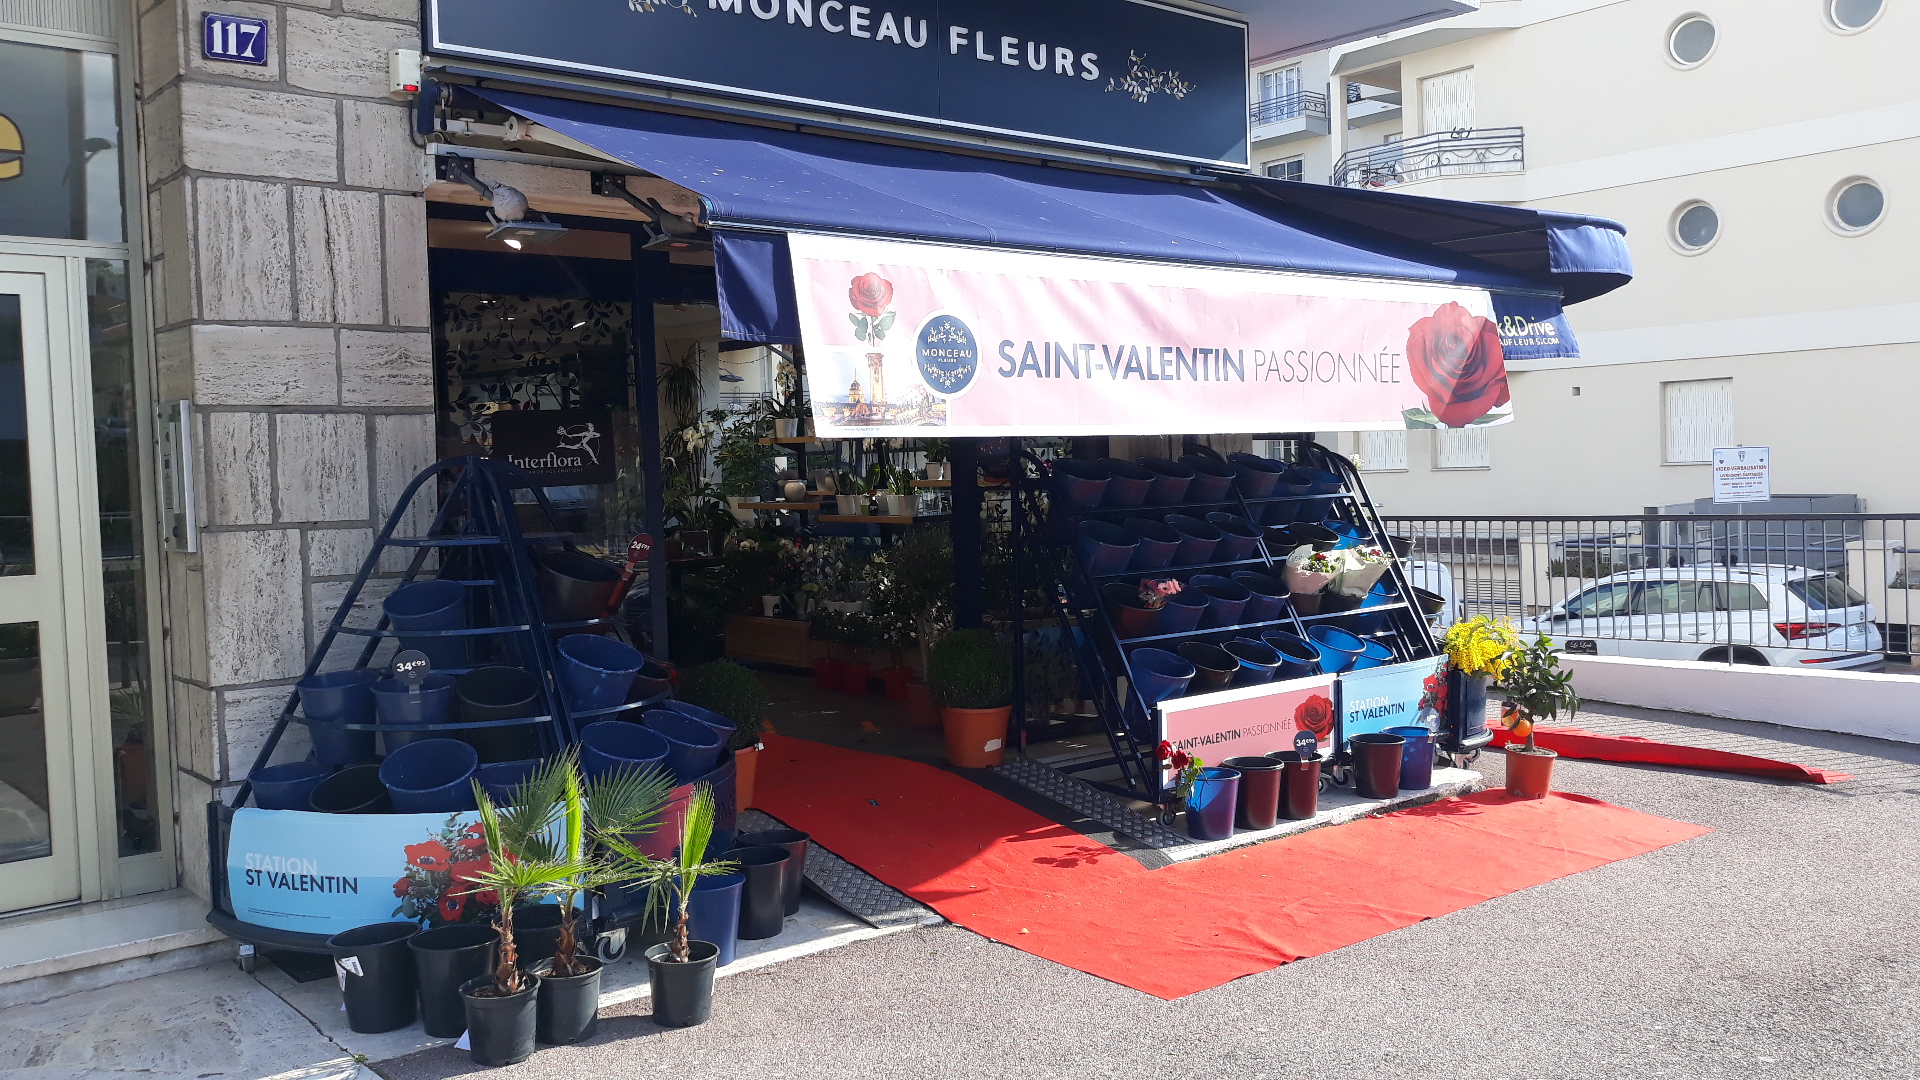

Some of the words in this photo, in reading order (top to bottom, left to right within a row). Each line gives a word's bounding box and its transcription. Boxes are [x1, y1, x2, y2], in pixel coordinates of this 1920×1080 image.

[211, 20, 261, 58] 117
[950, 25, 1100, 81] FLEURS
[922, 348, 972, 358] MONCEAU
[998, 339, 1244, 382] SAINT-VALENTIN
[1254, 346, 1400, 383] PASSIONNÉE
[396, 660, 426, 672] 34€95
[1349, 695, 1389, 712] STATION
[1349, 710, 1360, 724] ST
[1361, 701, 1405, 720] VALENTIN
[1243, 717, 1292, 738] PASSIONNÉE
[244, 852, 318, 875] STATION
[245, 868, 262, 887] ST
[266, 870, 358, 894] VALENTIN
